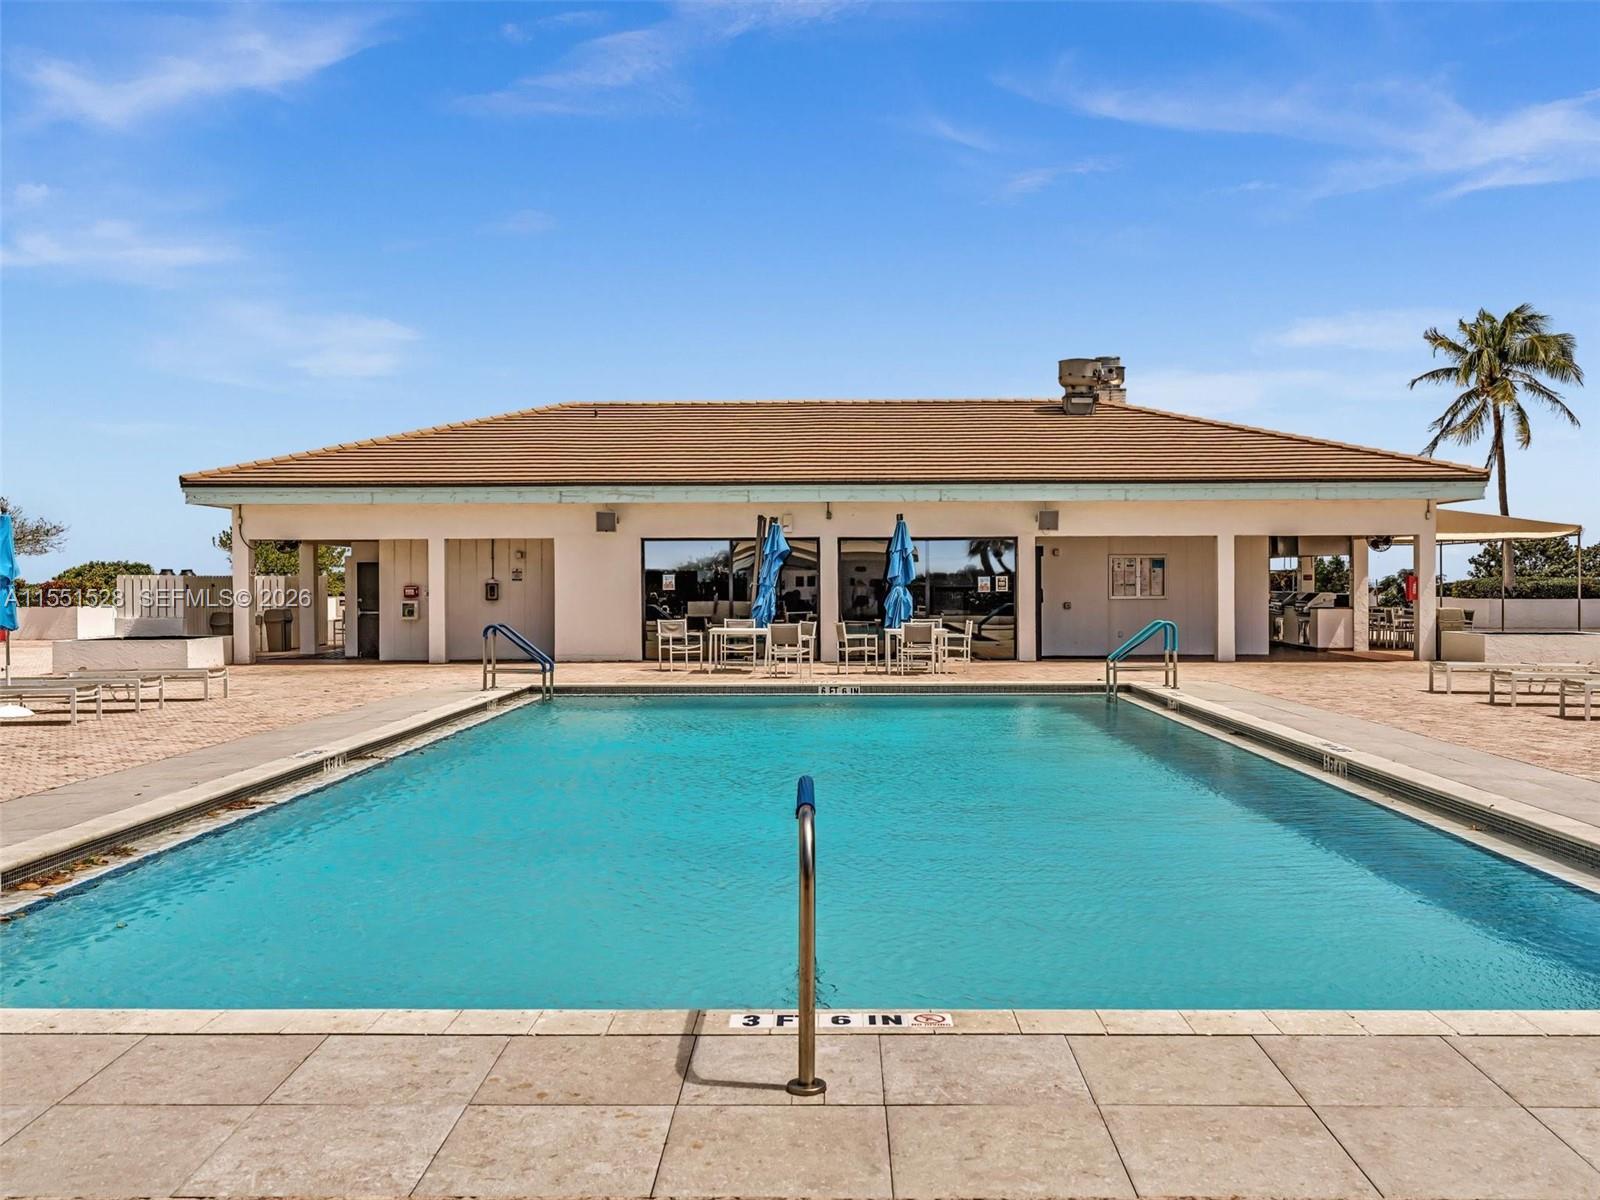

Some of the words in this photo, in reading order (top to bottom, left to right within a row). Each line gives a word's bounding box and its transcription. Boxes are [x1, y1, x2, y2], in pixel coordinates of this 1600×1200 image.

[742, 1015, 760, 1026] 3
[831, 1015, 851, 1025] 6
[868, 1015, 903, 1026] IN
